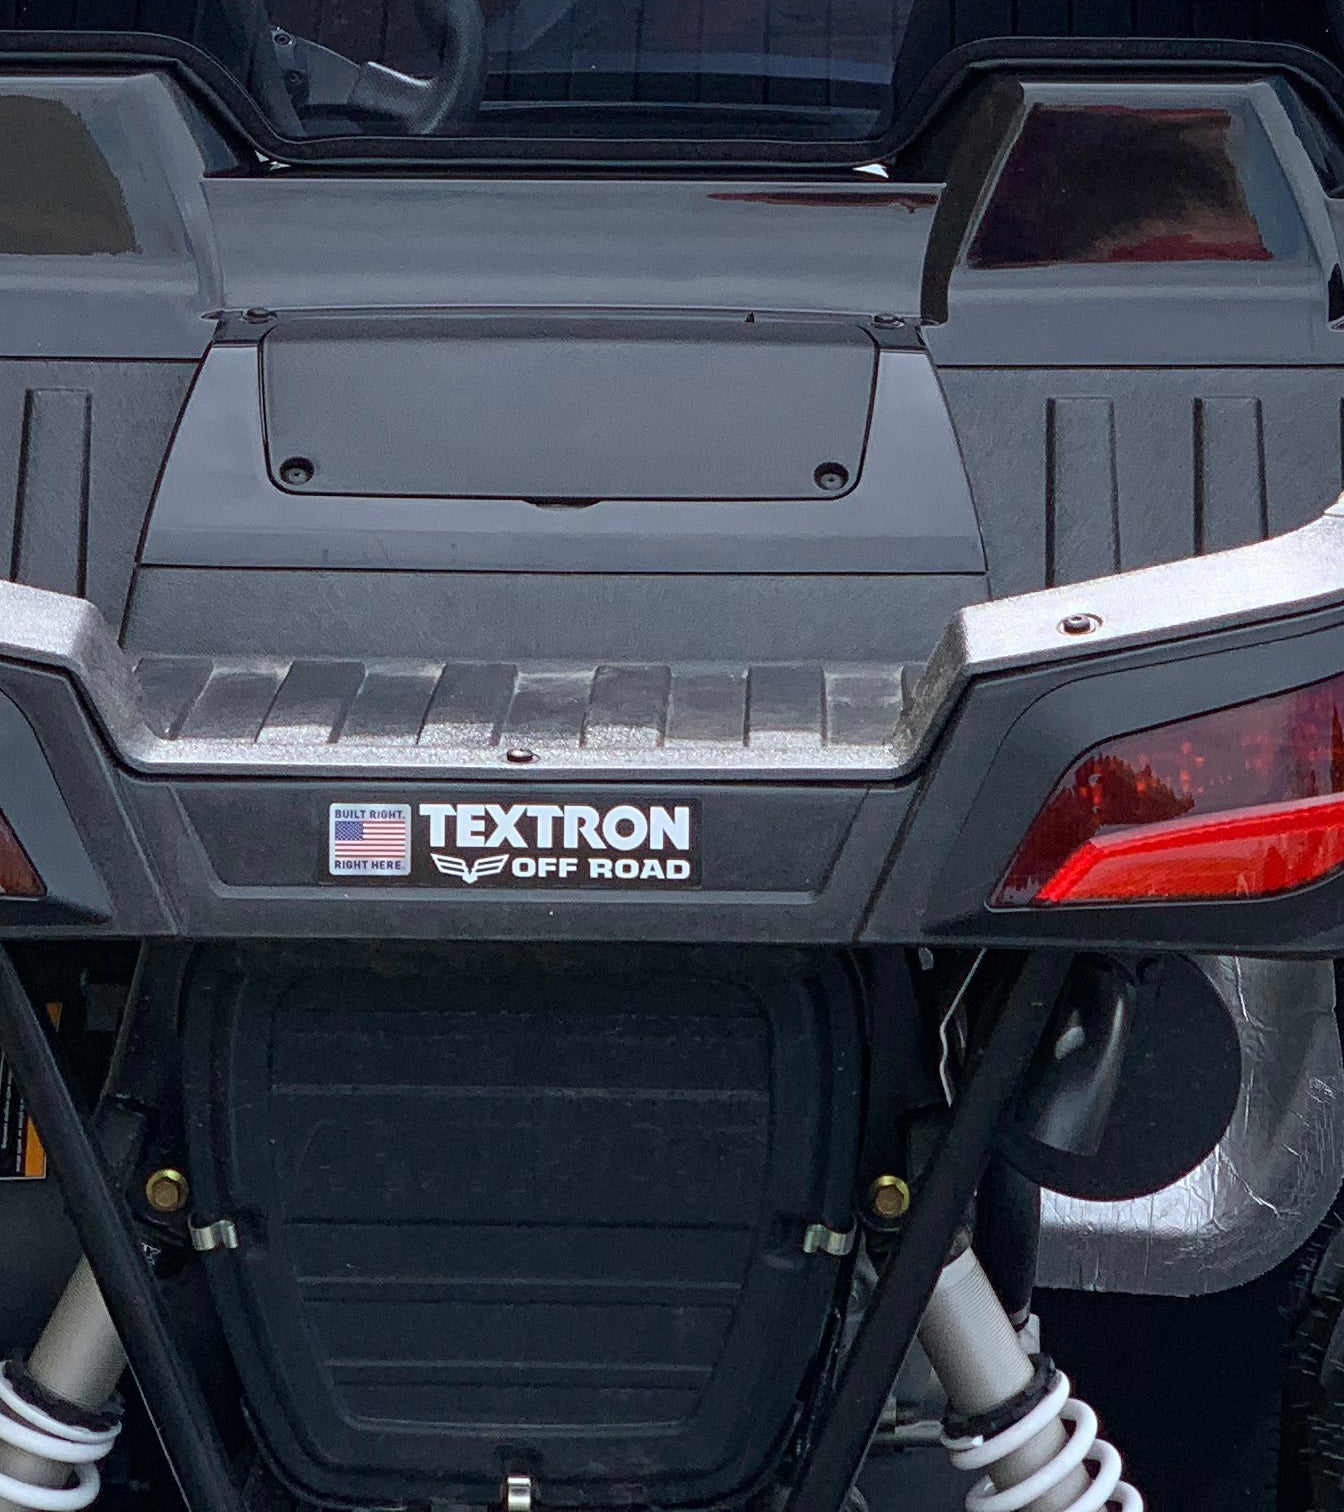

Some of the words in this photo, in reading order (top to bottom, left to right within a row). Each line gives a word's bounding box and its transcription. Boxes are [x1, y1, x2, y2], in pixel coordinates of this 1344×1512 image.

[335, 810, 366, 819] BUILT
[369, 810, 406, 819] RIGHT.
[419, 804, 690, 851] TEXTRON
[334, 860, 368, 870] RIGHT
[512, 858, 577, 878] OFF
[588, 858, 690, 879] ROAD
